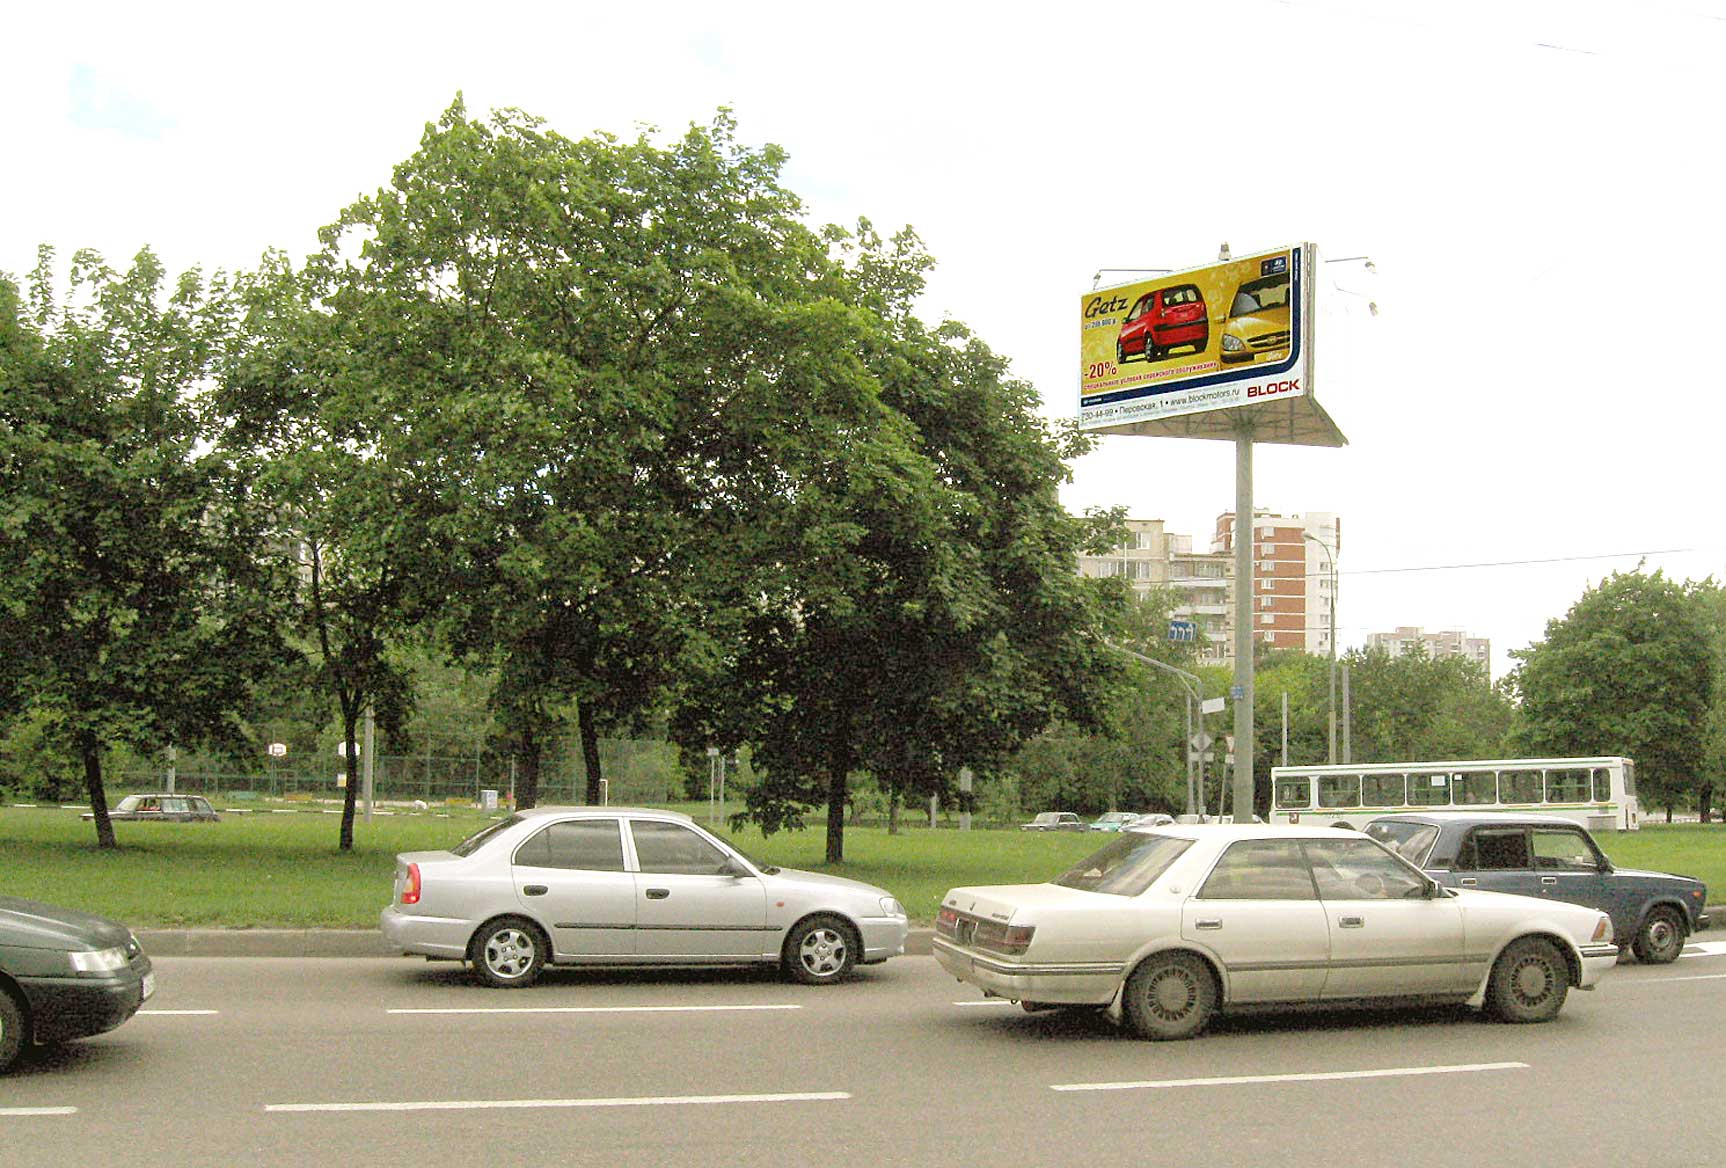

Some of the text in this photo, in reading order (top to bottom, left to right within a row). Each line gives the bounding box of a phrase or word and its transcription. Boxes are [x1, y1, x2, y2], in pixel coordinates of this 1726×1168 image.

[1085, 296, 1128, 318] Getz
[1084, 361, 1117, 379] -20%
[1247, 379, 1300, 398] BLOCK
